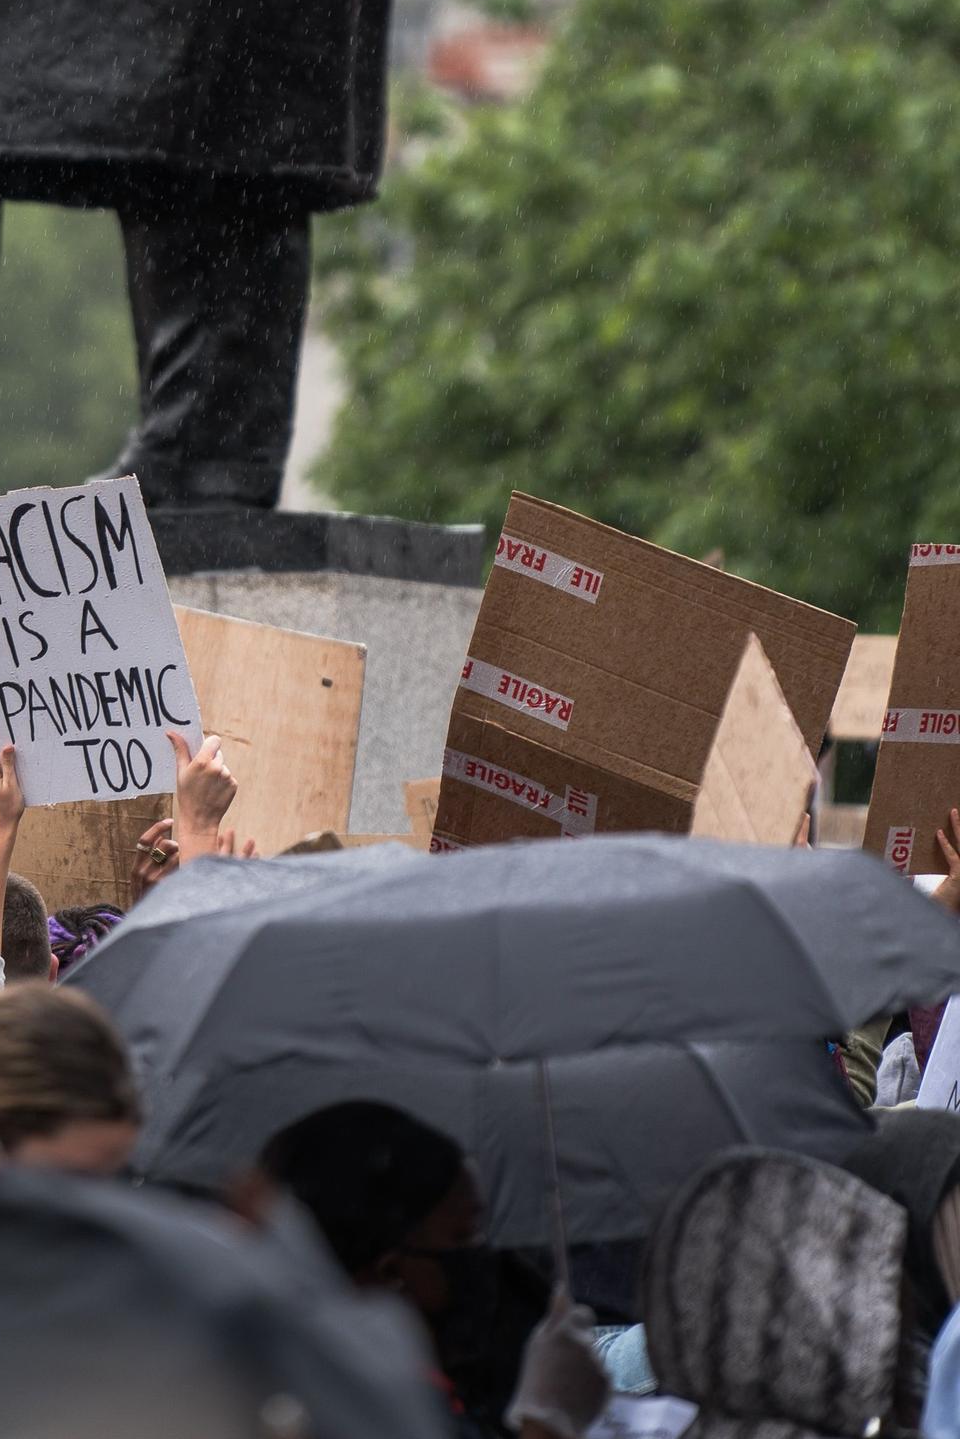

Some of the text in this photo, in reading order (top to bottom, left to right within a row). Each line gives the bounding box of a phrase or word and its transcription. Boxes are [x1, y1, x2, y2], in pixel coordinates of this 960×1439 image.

[570, 567, 601, 594] ILE
[2, 600, 118, 667] IS A
[497, 674, 572, 721] RAGILE
[920, 712, 960, 734] GILE
[64, 738, 152, 794] TOO
[465, 761, 552, 809] FRAGILE
